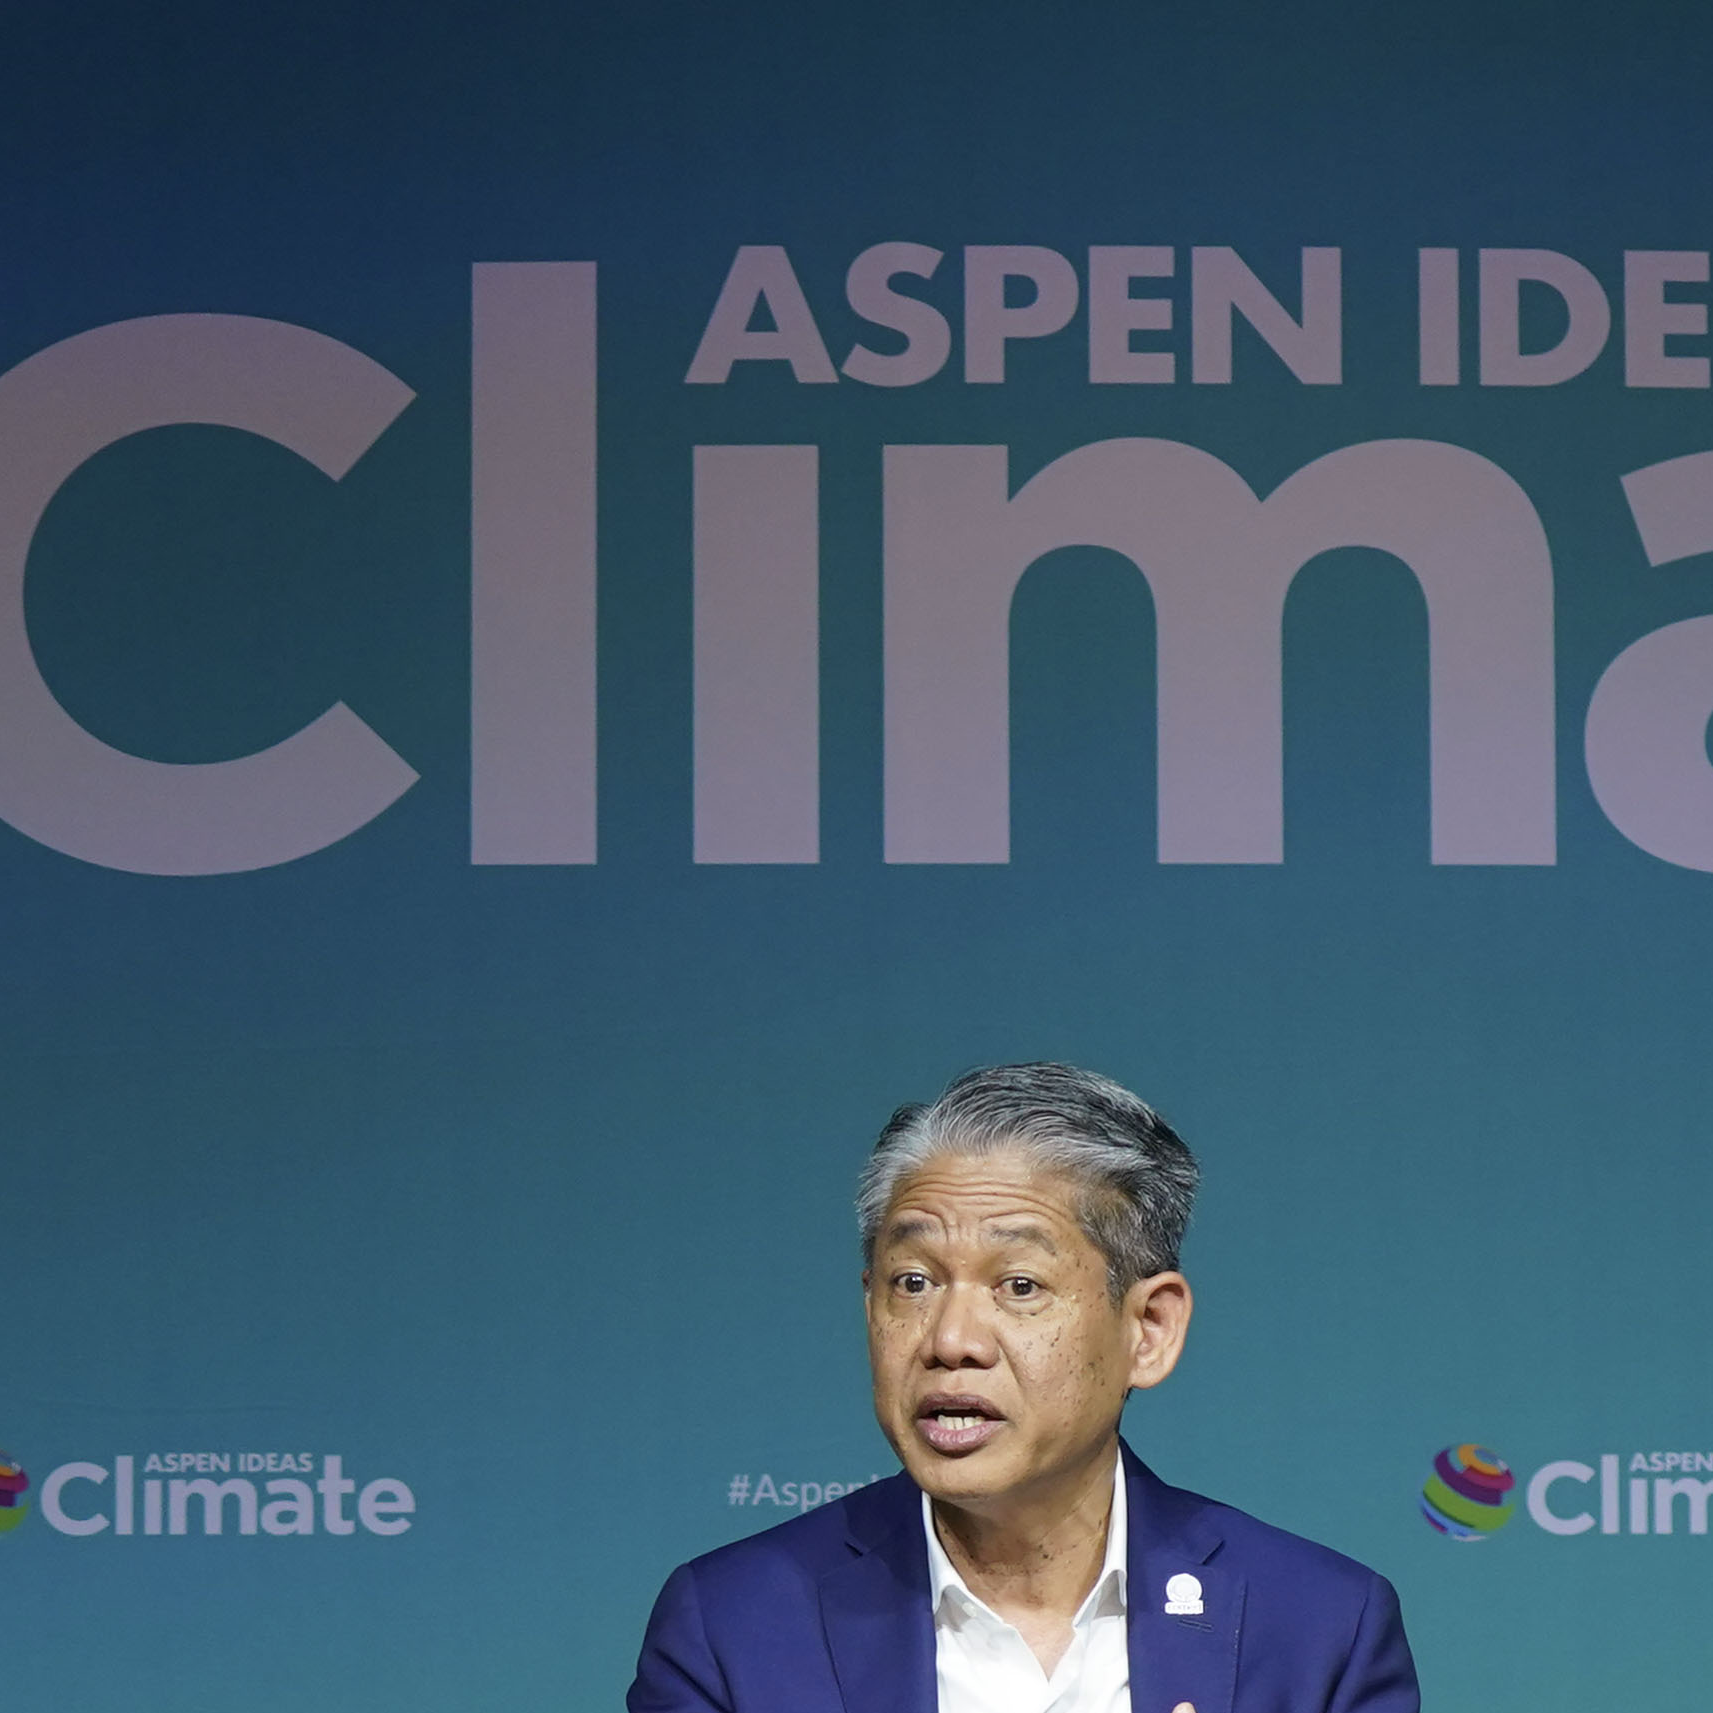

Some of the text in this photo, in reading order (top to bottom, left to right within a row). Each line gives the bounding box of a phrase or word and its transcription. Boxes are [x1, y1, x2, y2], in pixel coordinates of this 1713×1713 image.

[683, 245, 1343, 388] ASPEN
[40, 1455, 416, 1537] Climate
[144, 1452, 314, 1473] ASPEN IDEAS
